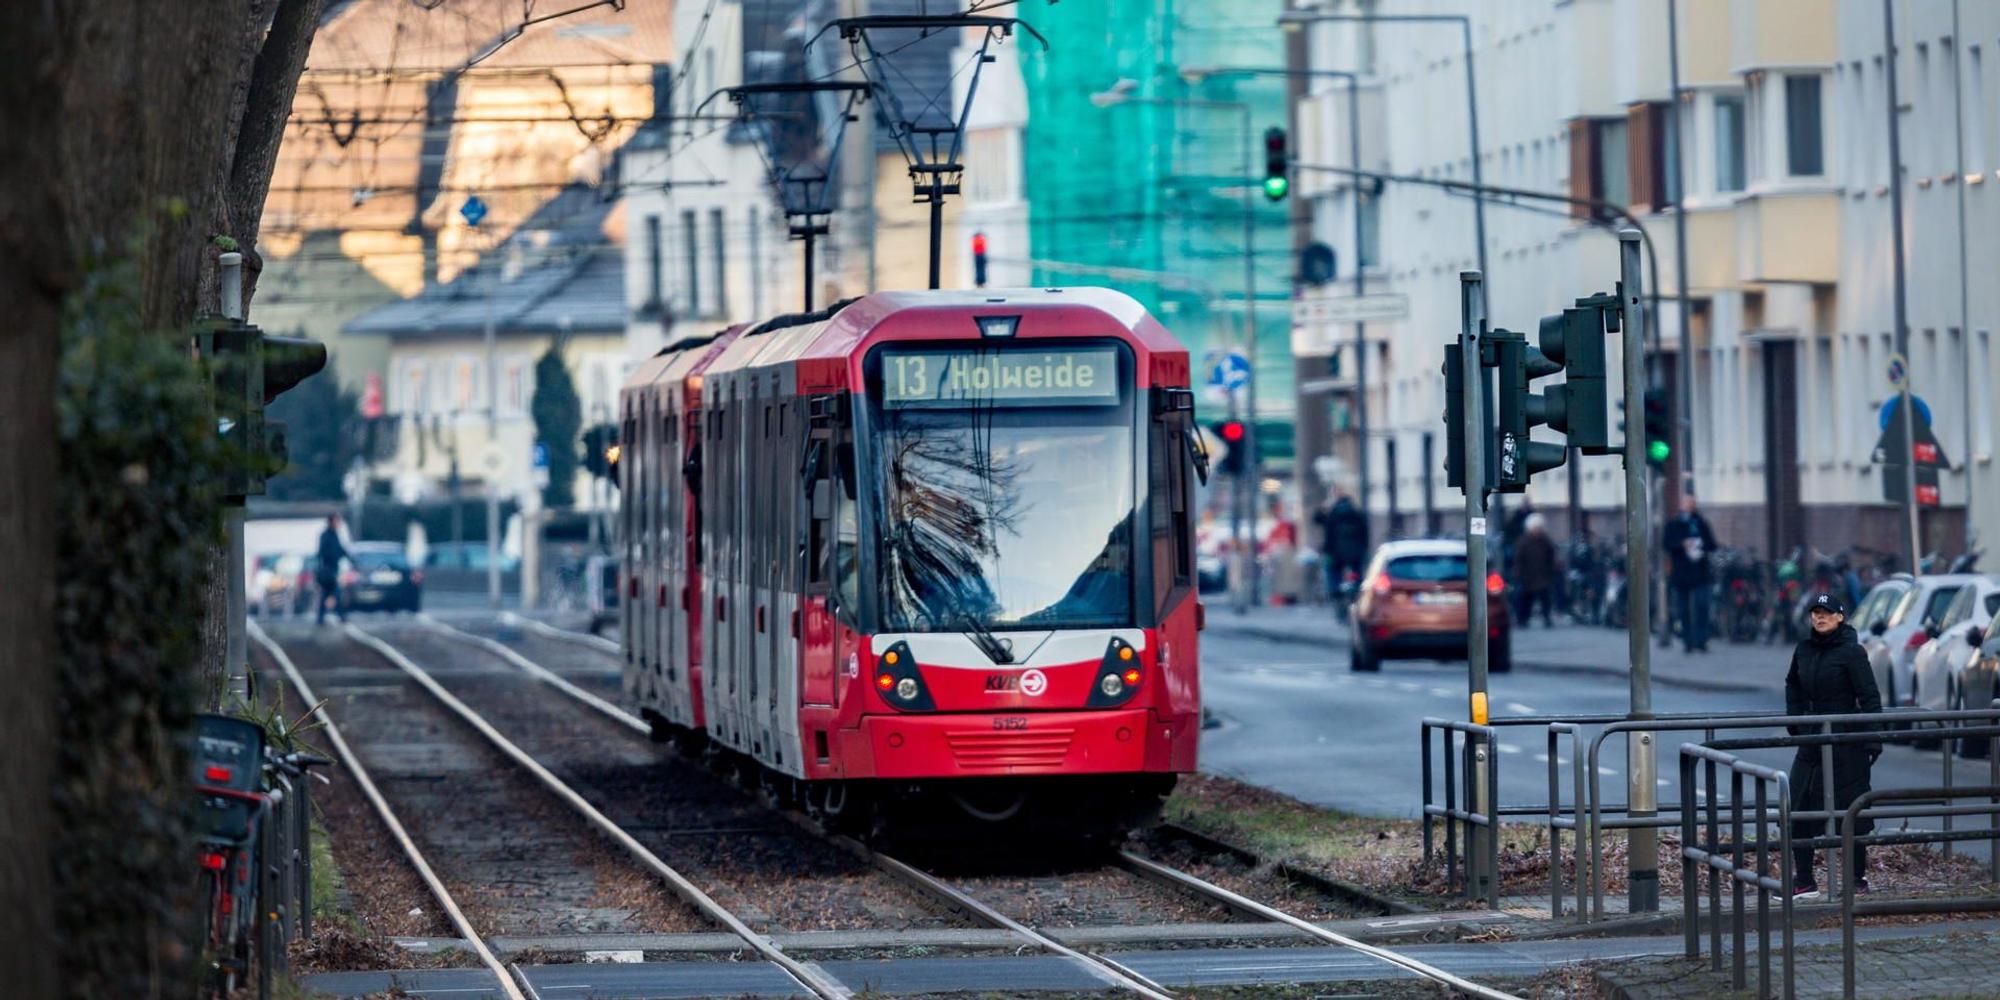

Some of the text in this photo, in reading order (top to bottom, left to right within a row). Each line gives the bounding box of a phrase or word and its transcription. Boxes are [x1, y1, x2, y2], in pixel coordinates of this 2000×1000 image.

[895, 355, 1095, 396] 13 Holweide
[992, 717, 1028, 731] 5152
